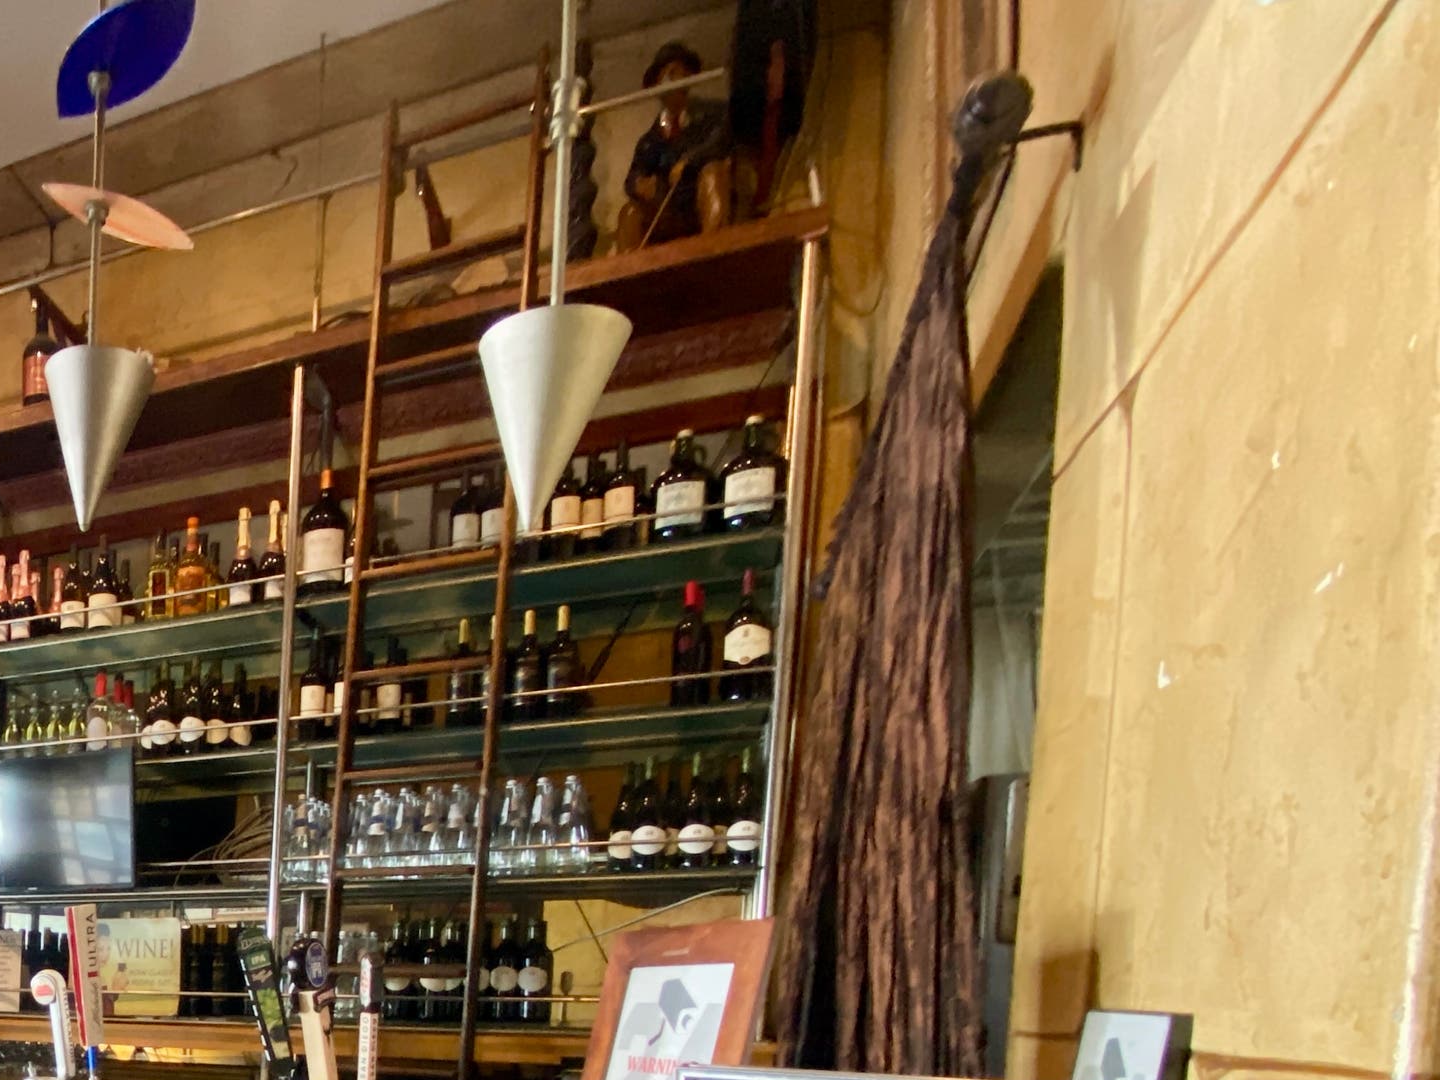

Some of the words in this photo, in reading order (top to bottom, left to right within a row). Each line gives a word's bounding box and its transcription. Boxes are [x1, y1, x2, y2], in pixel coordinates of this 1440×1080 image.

[86, 913, 98, 968] ULTRA
[115, 938, 175, 960] WINE!
[627, 1055, 678, 1075] WARNIN
